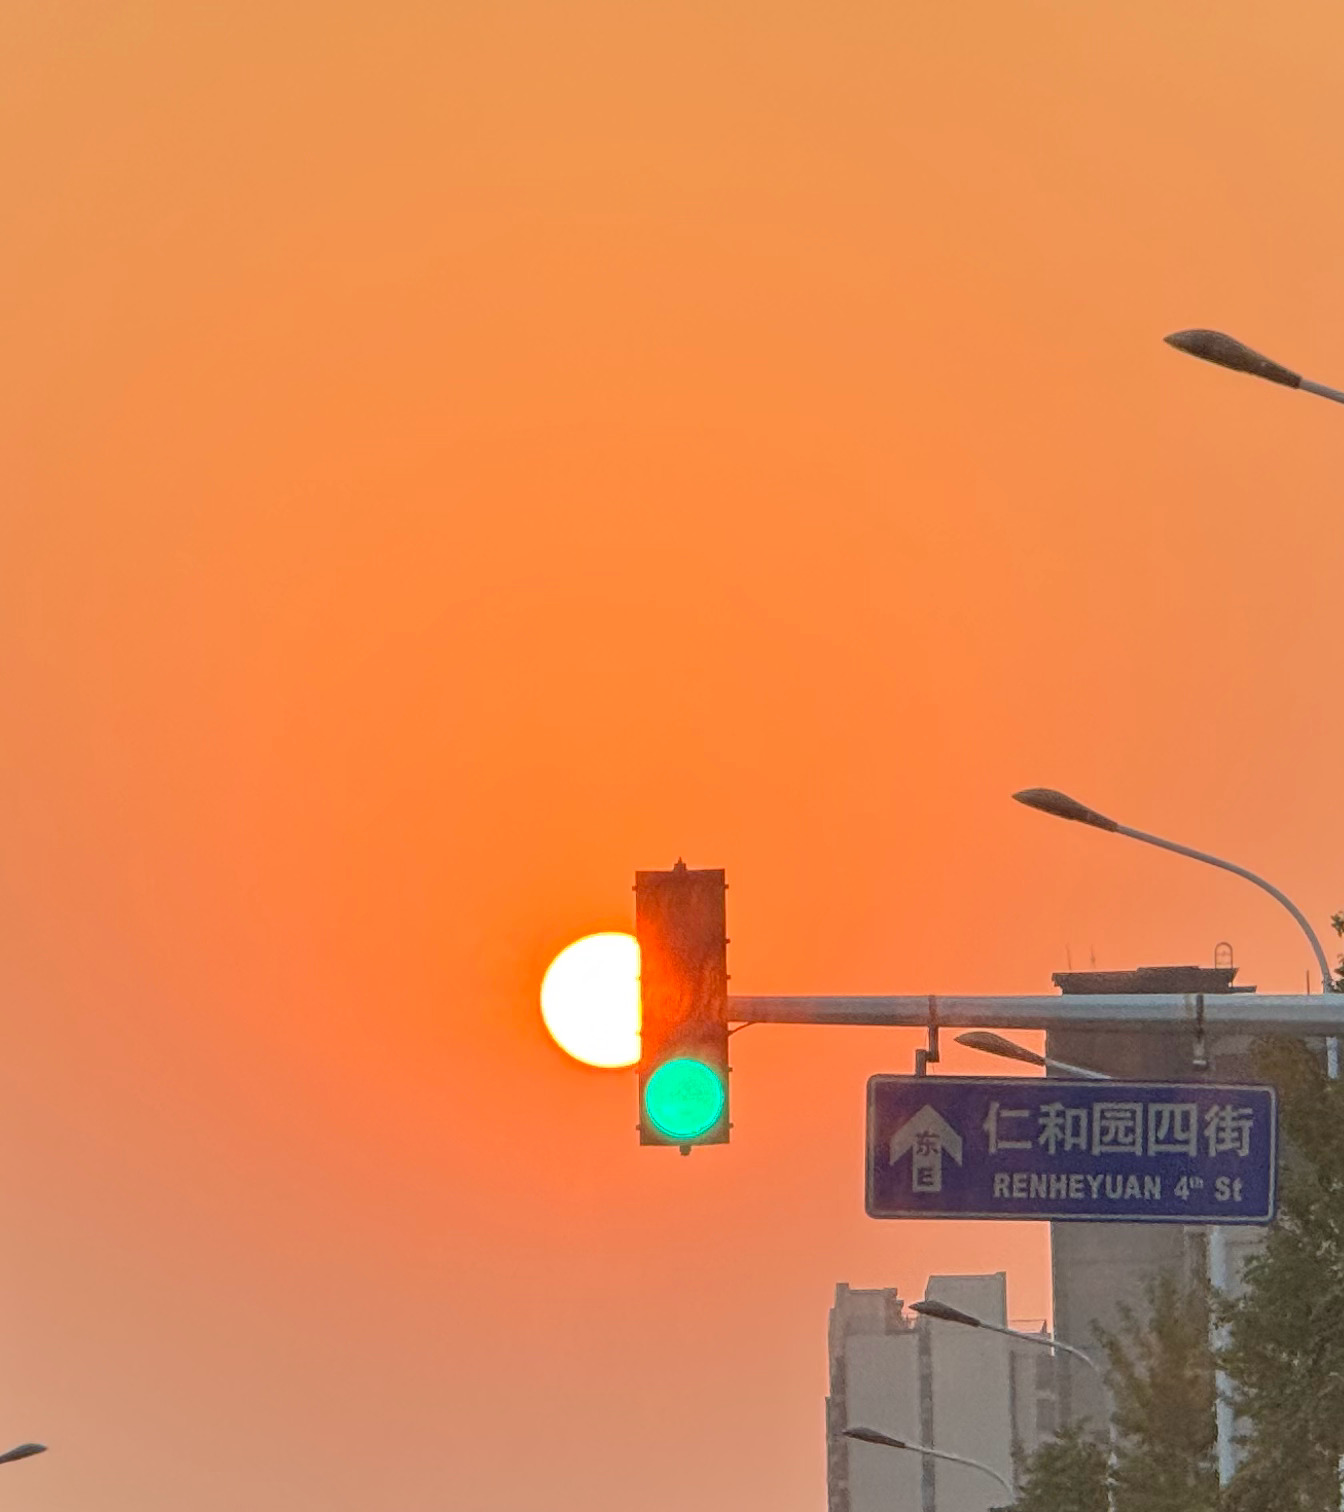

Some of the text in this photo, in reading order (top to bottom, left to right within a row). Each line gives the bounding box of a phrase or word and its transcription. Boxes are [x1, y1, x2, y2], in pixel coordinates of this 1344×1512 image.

[916, 1130, 940, 1156] 东
[983, 1102, 1254, 1157] 仁和园四街
[917, 1167, 934, 1186] E
[993, 1172, 1161, 1200] RENHEYUAN
[1215, 1176, 1242, 1201] St
